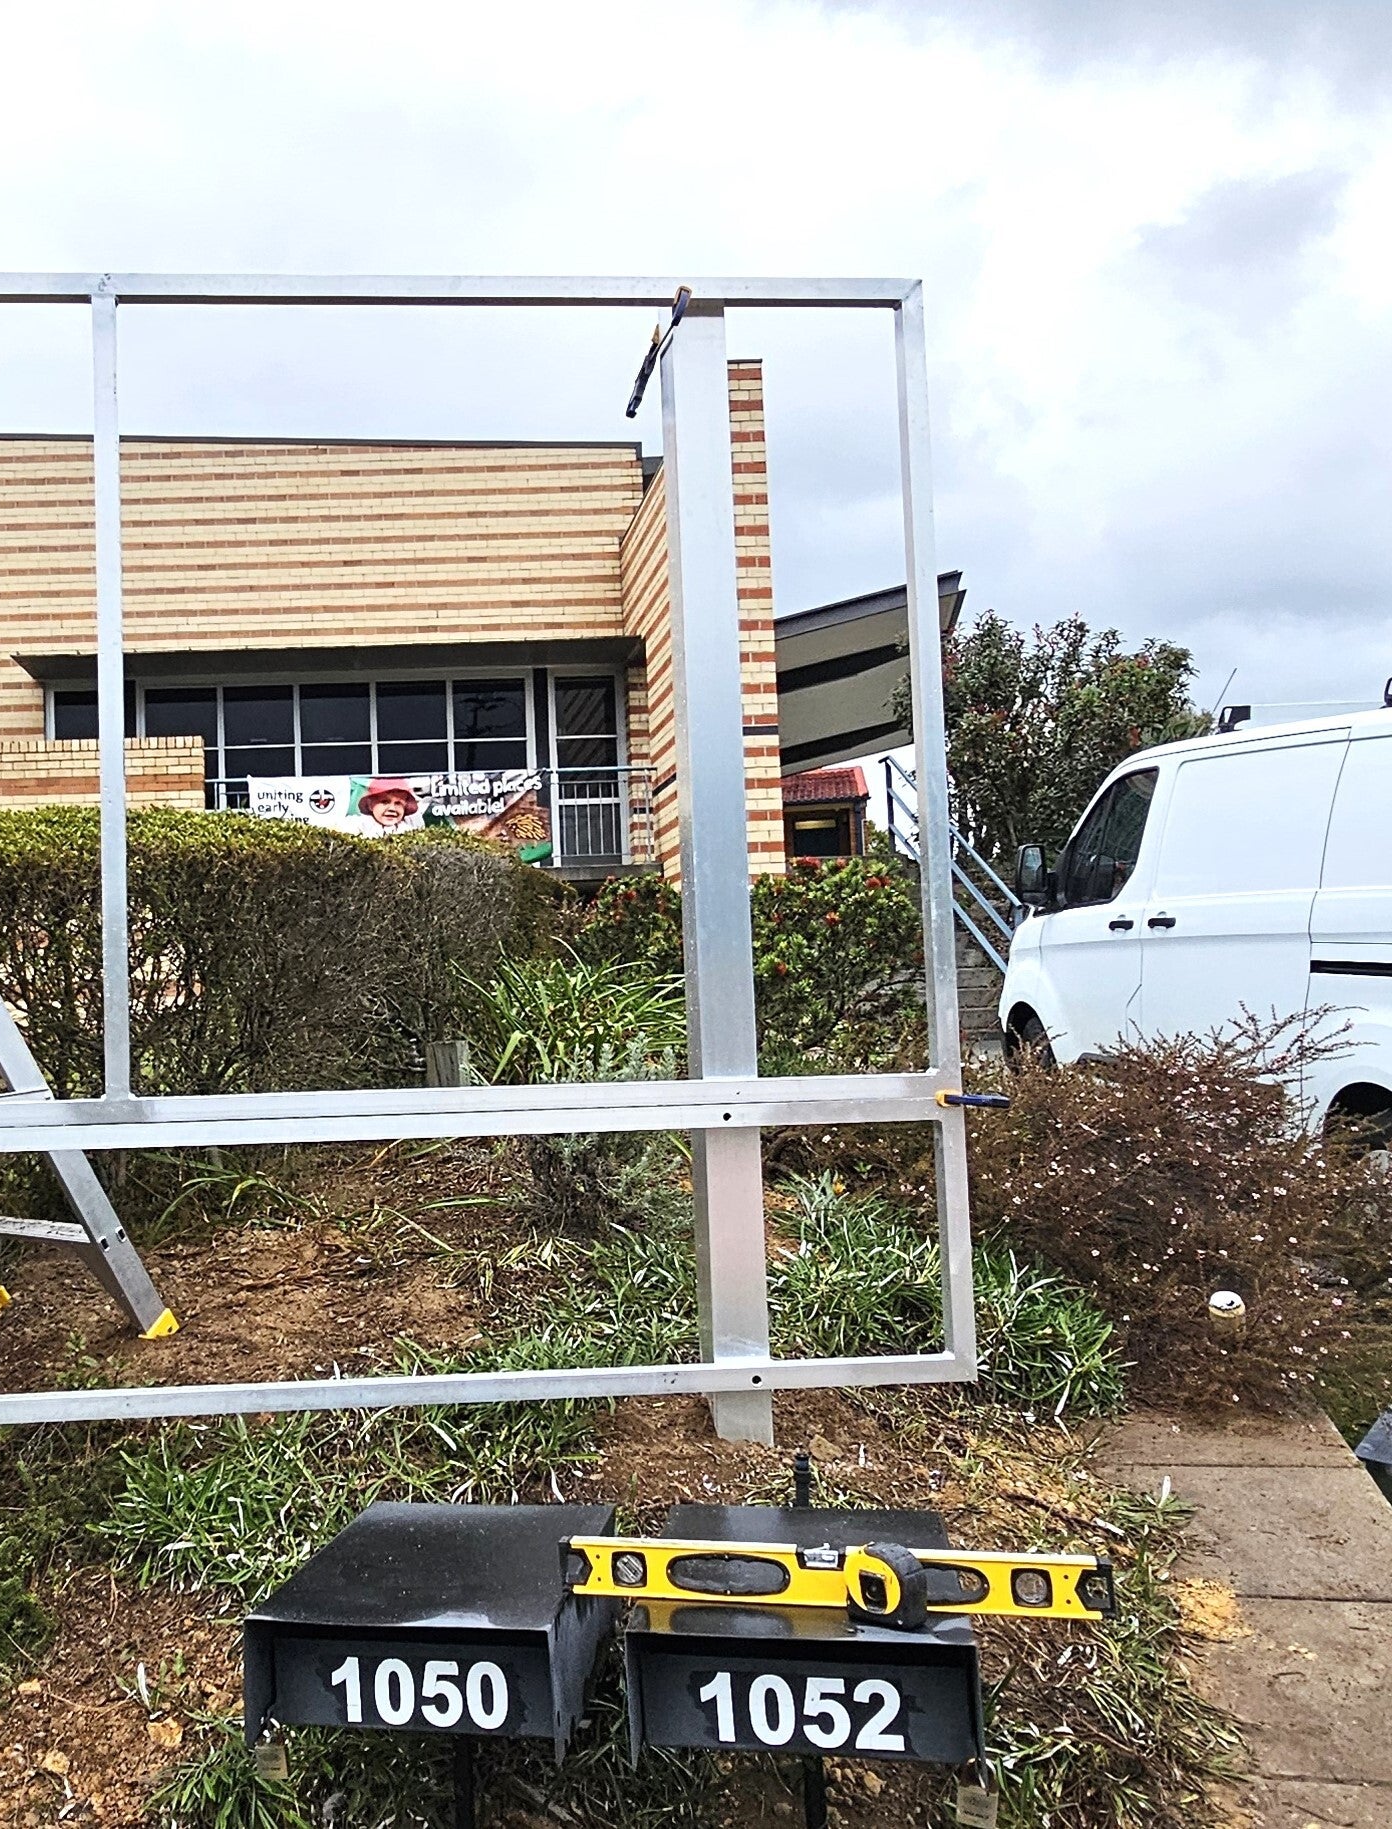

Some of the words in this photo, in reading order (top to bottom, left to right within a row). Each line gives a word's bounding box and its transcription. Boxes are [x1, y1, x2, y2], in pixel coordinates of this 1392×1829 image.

[257, 789, 304, 803] uniting
[431, 778, 490, 797] Limited
[493, 775, 543, 797] places
[257, 801, 290, 819] early
[330, 1655, 510, 1731] 1050
[698, 1671, 906, 1752] 1052
